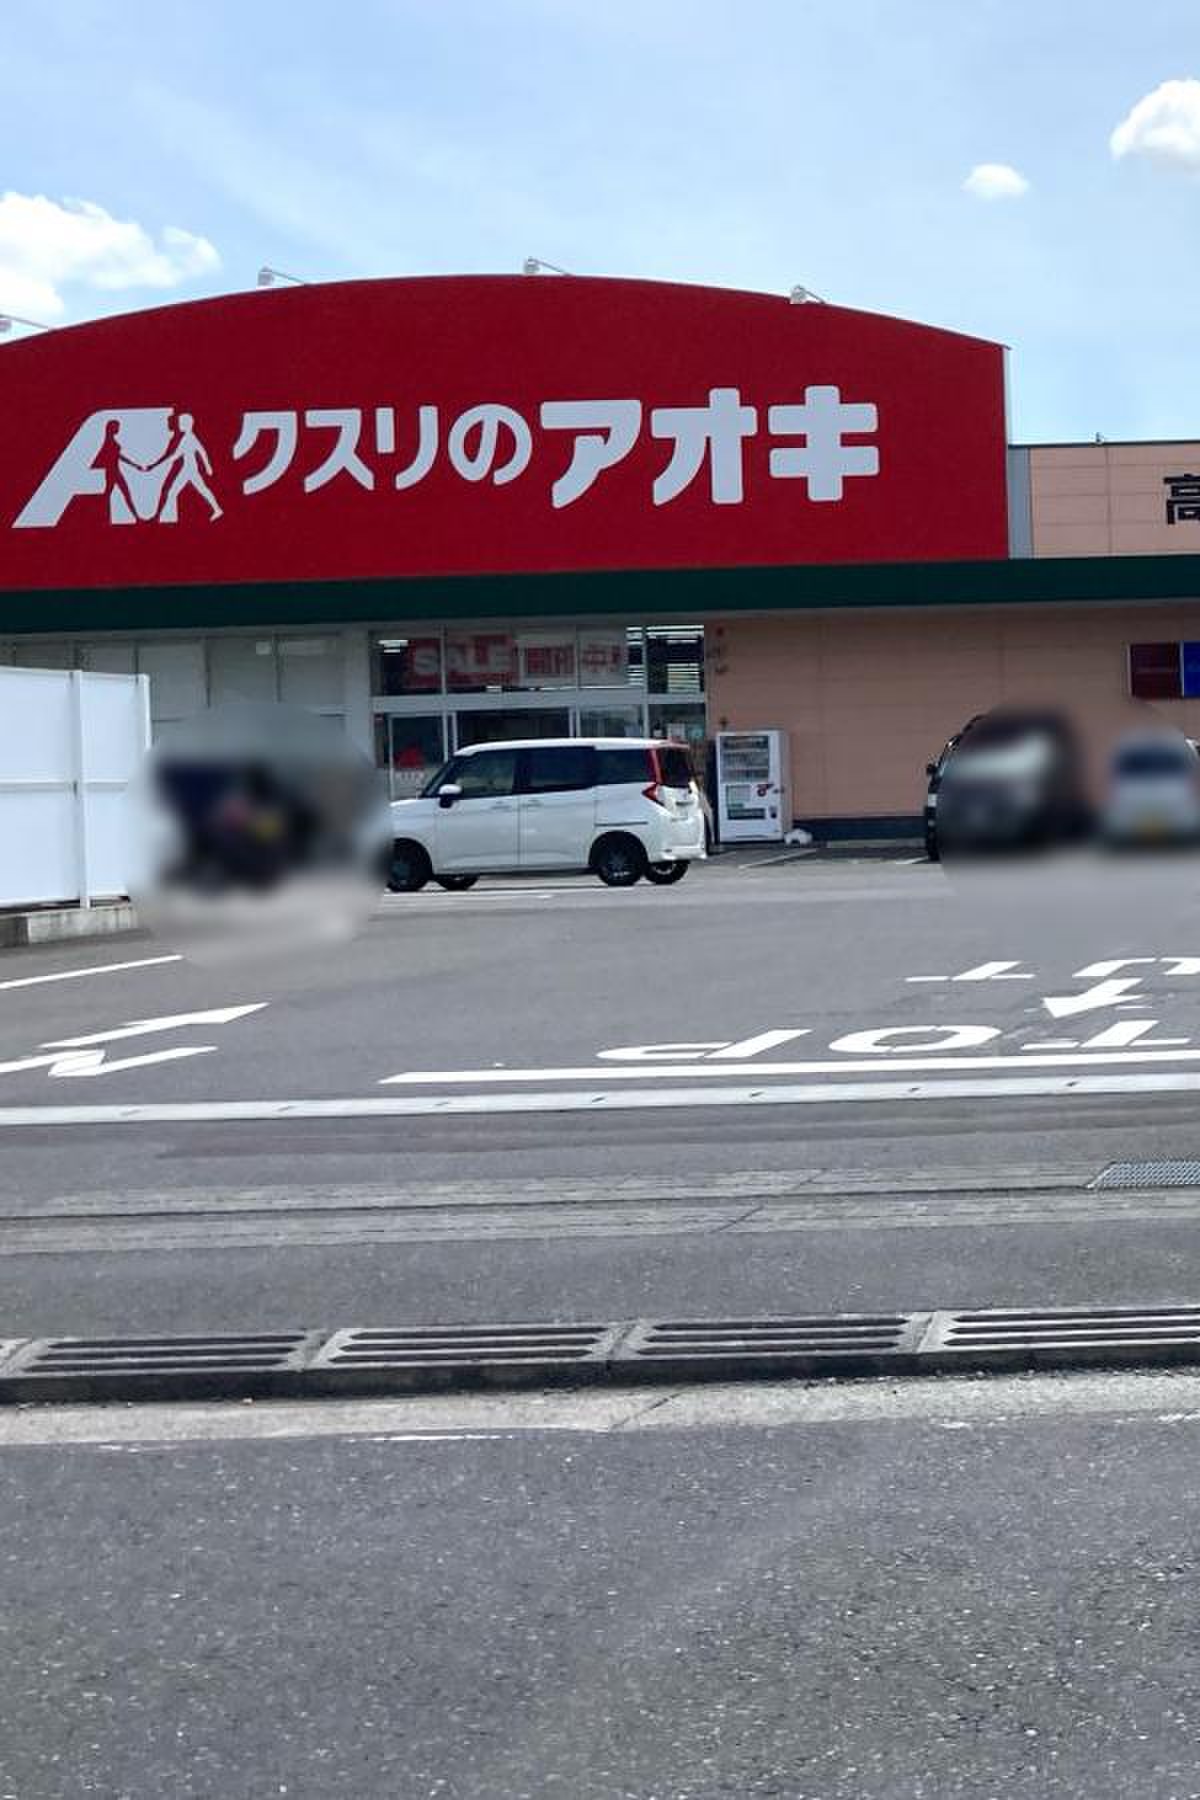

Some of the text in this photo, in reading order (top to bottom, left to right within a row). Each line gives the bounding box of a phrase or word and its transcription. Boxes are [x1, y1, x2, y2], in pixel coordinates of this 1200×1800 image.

[231, 384, 881, 509] クスリのアオキ
